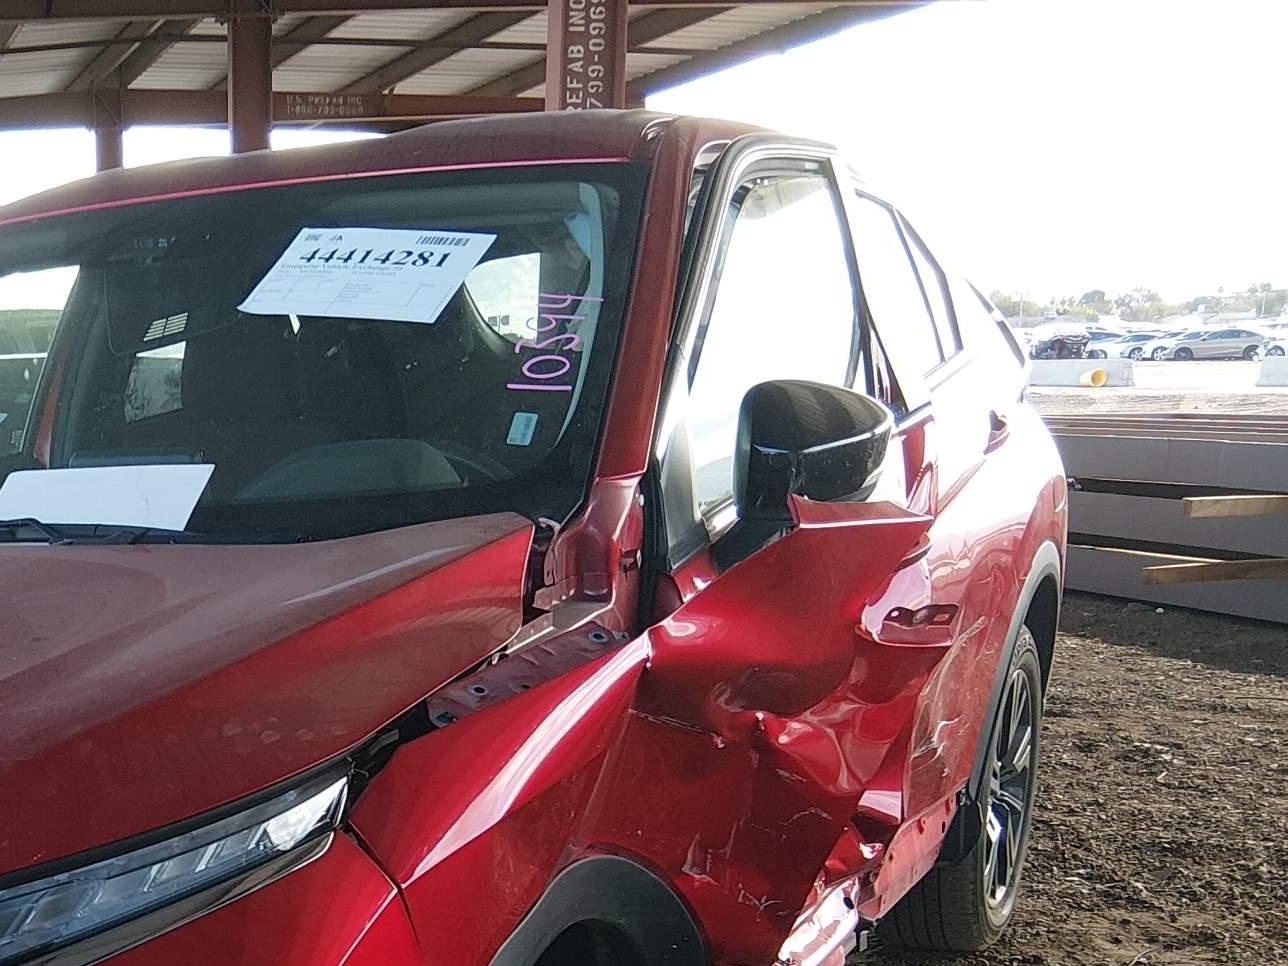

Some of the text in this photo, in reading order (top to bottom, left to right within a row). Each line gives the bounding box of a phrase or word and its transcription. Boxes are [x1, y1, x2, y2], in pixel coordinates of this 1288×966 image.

[586, 0, 606, 109] 799-096
[300, 248, 451, 267] 44414281
[506, 292, 604, 391] 10394
